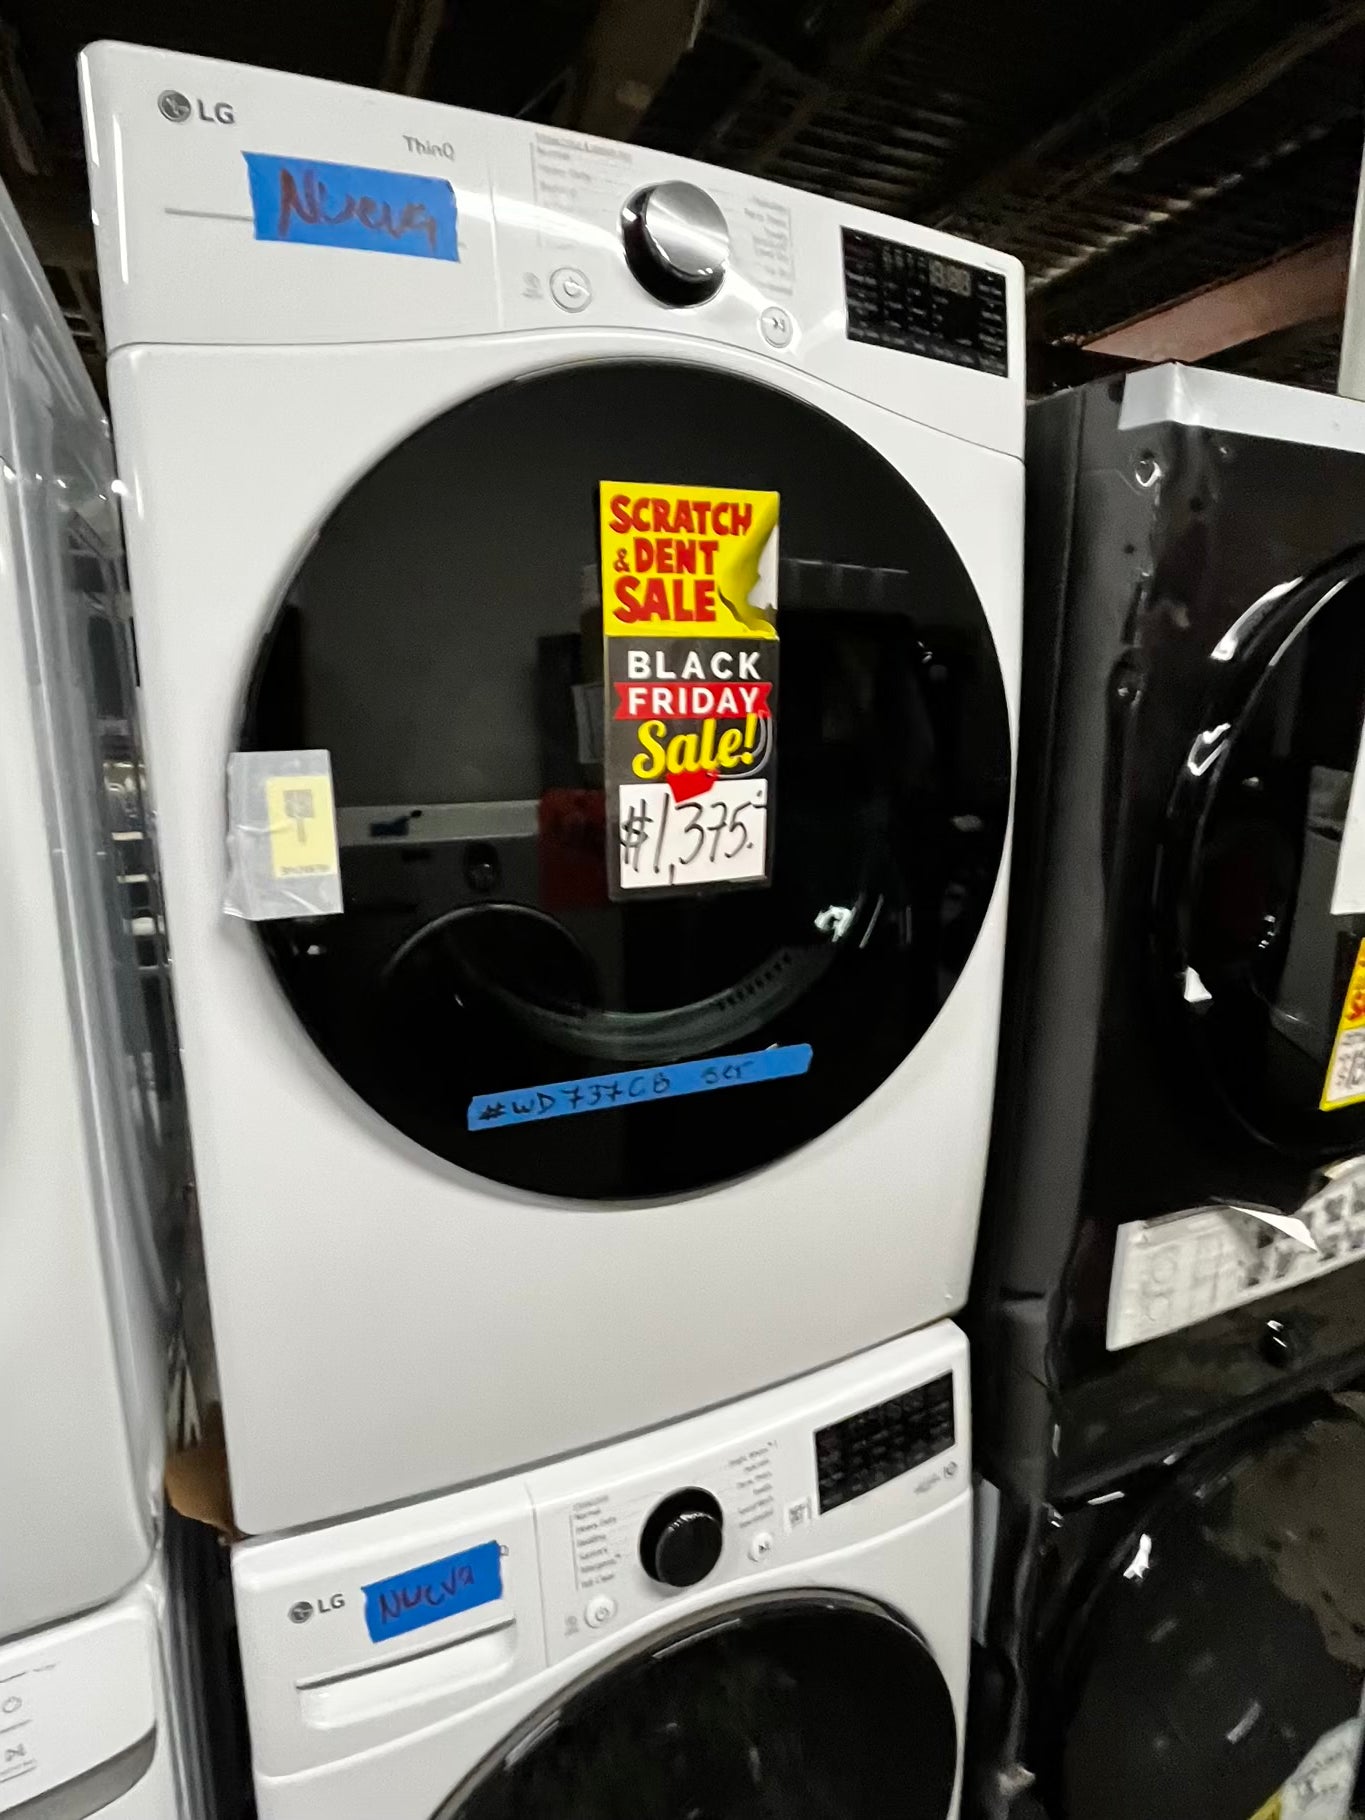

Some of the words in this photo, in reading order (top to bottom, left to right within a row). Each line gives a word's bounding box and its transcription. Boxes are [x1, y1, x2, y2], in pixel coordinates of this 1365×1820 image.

[197, 98, 235, 125] LG
[403, 134, 455, 161] ThinQ
[609, 494, 752, 536] SCRATCH
[613, 548, 630, 573] &
[634, 537, 719, 575] DENT
[613, 575, 717, 623] SALE
[627, 650, 762, 680] BLACK
[628, 687, 759, 715] FRIDAY
[632, 712, 757, 779] Sale!
[317, 1593, 346, 1614] LG
